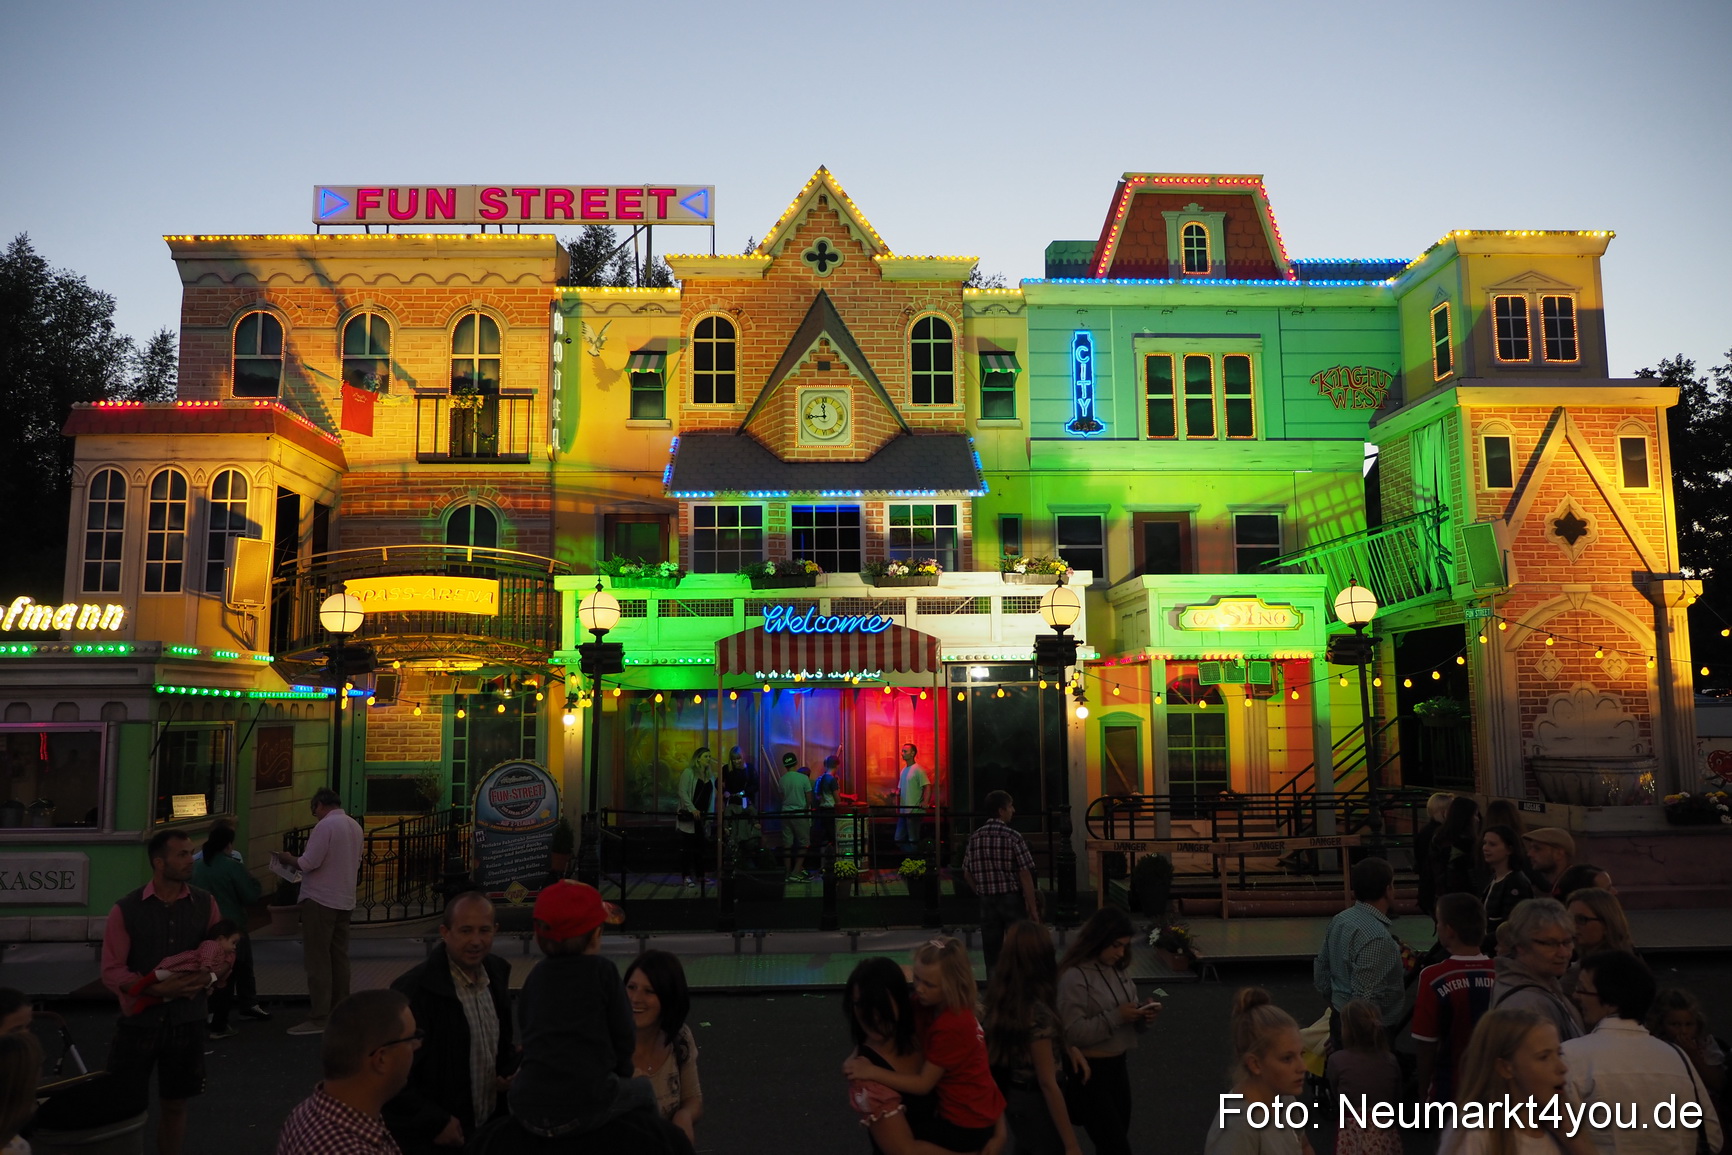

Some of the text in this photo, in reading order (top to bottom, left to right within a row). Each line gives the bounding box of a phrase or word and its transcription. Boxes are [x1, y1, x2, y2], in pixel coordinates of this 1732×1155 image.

[355, 187, 677, 221] FUN STREET
[1075, 345, 1092, 418] CITY
[1325, 388, 1390, 411] WEST
[1073, 421, 1097, 432] BAR
[762, 604, 894, 635] Welcome
[1192, 604, 1287, 626] CASINO
[491, 784, 545, 803] FUN-STREET
[1114, 842, 1146, 852] DANGER
[1177, 842, 1210, 853] DANGER
[1252, 841, 1285, 850] DANGER
[1309, 836, 1342, 847] DANGER
[1437, 977, 1470, 998] BAYERN
